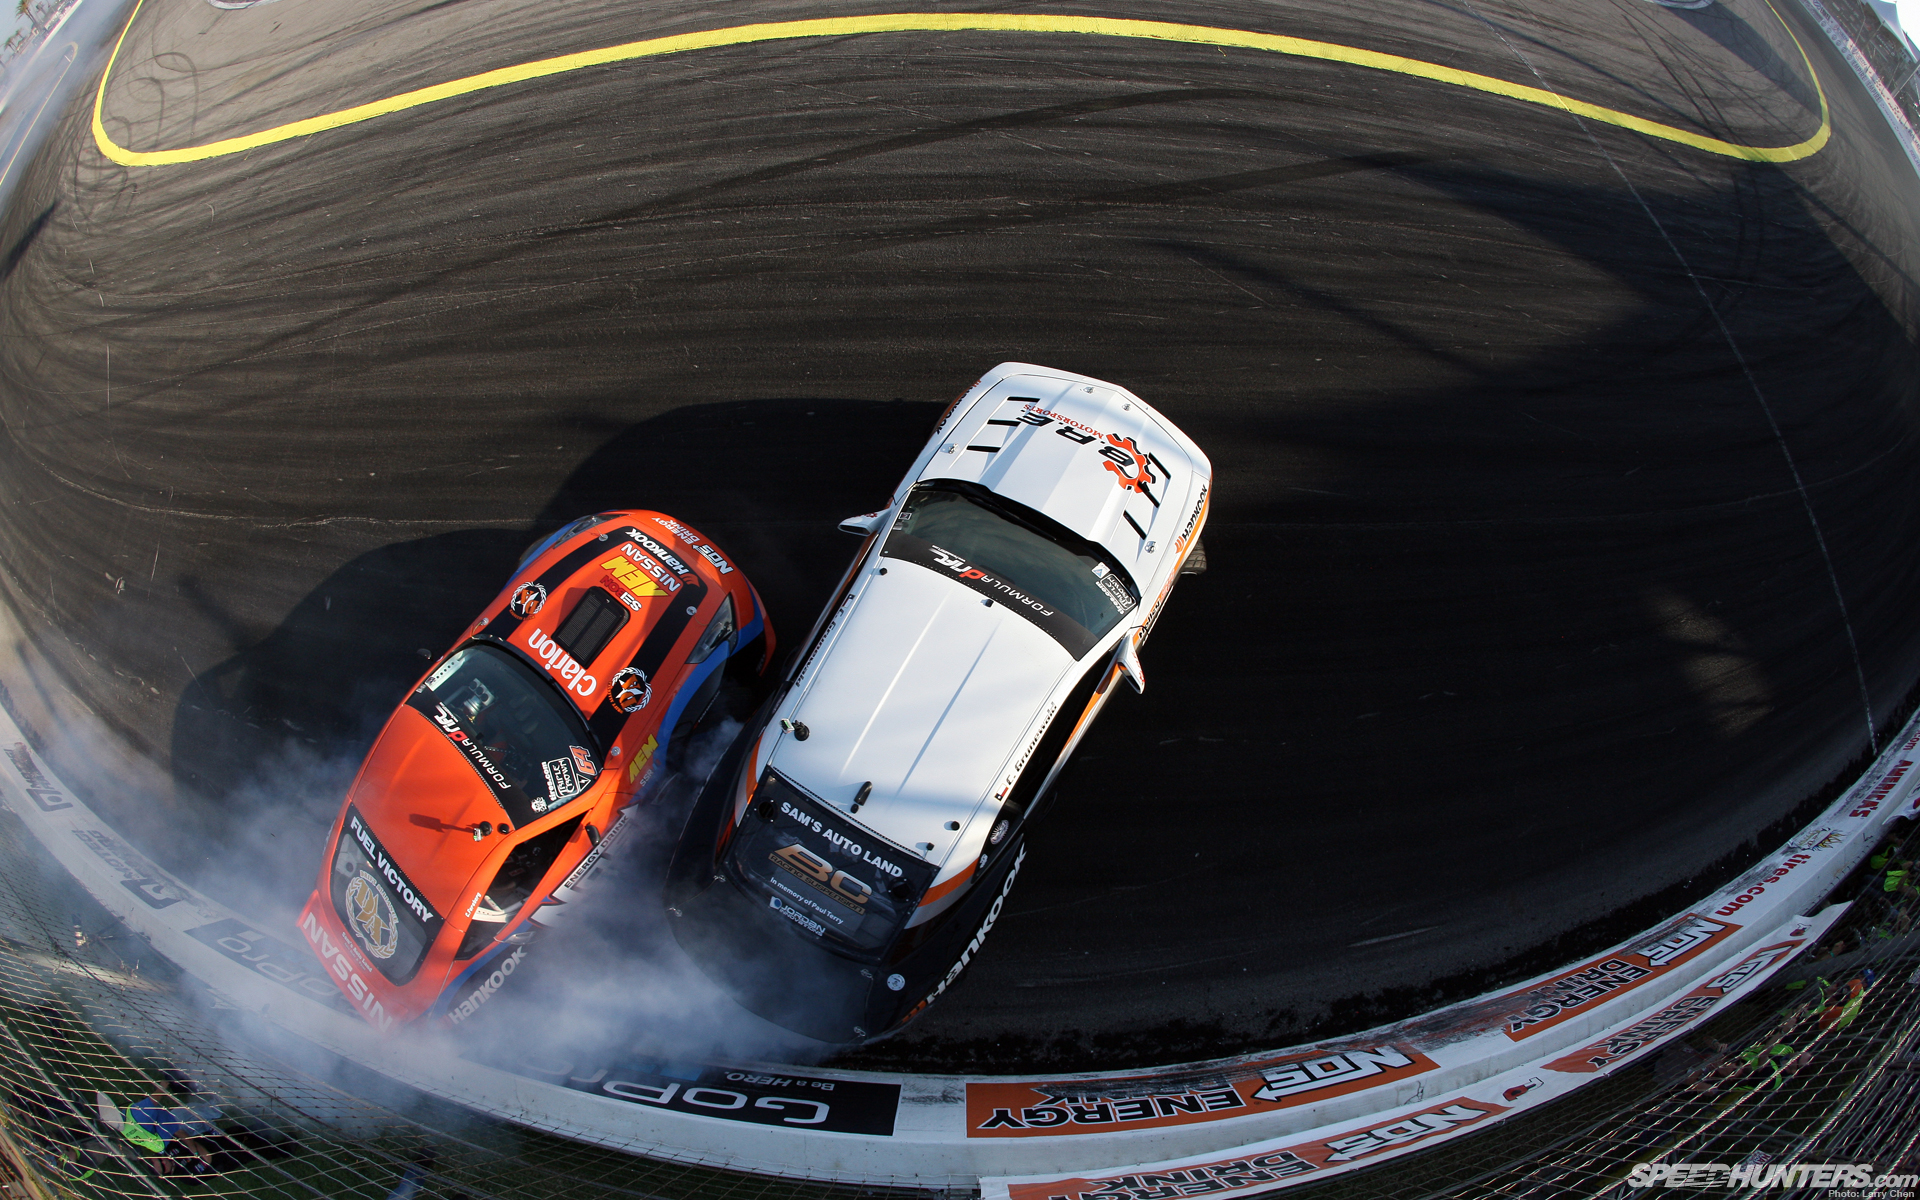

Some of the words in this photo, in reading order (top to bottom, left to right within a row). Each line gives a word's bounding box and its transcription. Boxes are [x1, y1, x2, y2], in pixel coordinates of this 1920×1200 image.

[1024, 403, 1104, 440] MOTORSPORTS
[626, 528, 689, 575] Hankook
[651, 517, 694, 545] ENERGY
[667, 519, 701, 544] DRINK
[601, 555, 669, 597] AEM
[621, 543, 681, 592] NISSAN
[693, 544, 734, 574] NOS
[600, 575, 642, 612] SEIBON
[981, 573, 1054, 617] FORMULA
[1104, 580, 1130, 608] TRIPLE
[1107, 575, 1134, 605] CROWN
[528, 627, 597, 696] Clarion
[462, 738, 511, 790] FORMULA
[541, 762, 556, 801] tires.com
[552, 765, 565, 795] TRIPLE
[559, 760, 574, 793] CROWN
[569, 745, 598, 775] 64
[629, 733, 660, 784] AEM
[1849, 759, 1914, 818] AMERICA'S
[564, 849, 600, 889] ENERGY
[601, 815, 629, 848] DRINK
[781, 801, 822, 833] SAM'S
[822, 828, 862, 855] AUTO
[862, 850, 903, 878] LAND
[350, 816, 377, 860] FUEL
[376, 852, 434, 923] VICTORY
[770, 852, 806, 879] RACING
[803, 875, 866, 915] SUSPENSION
[774, 843, 872, 905] BC
[1716, 853, 1812, 917] tires.com
[770, 876, 777, 885] In
[777, 880, 804, 900] memory
[803, 894, 812, 905] of
[811, 899, 826, 912] Paul
[826, 908, 844, 924] Terry
[779, 907, 824, 937] INNOVATIONS
[780, 905, 826, 934] JORDAN
[926, 843, 1027, 1005] Hankook
[302, 912, 394, 1033] NISSAN
[448, 945, 527, 1025] Hankook
[1510, 966, 1653, 1033] ENERGY
[1587, 996, 1720, 1068] ENERGY
[1588, 996, 1703, 1051] DRINK
[724, 1071, 792, 1088] HERO.
[795, 1079, 803, 1088] a
[811, 1079, 836, 1091] Be
[1252, 1046, 1417, 1102] NOS
[977, 1087, 1247, 1130] ENERGY
[1324, 1103, 1490, 1163] NOS
[1088, 1150, 1300, 1191] DRINK
